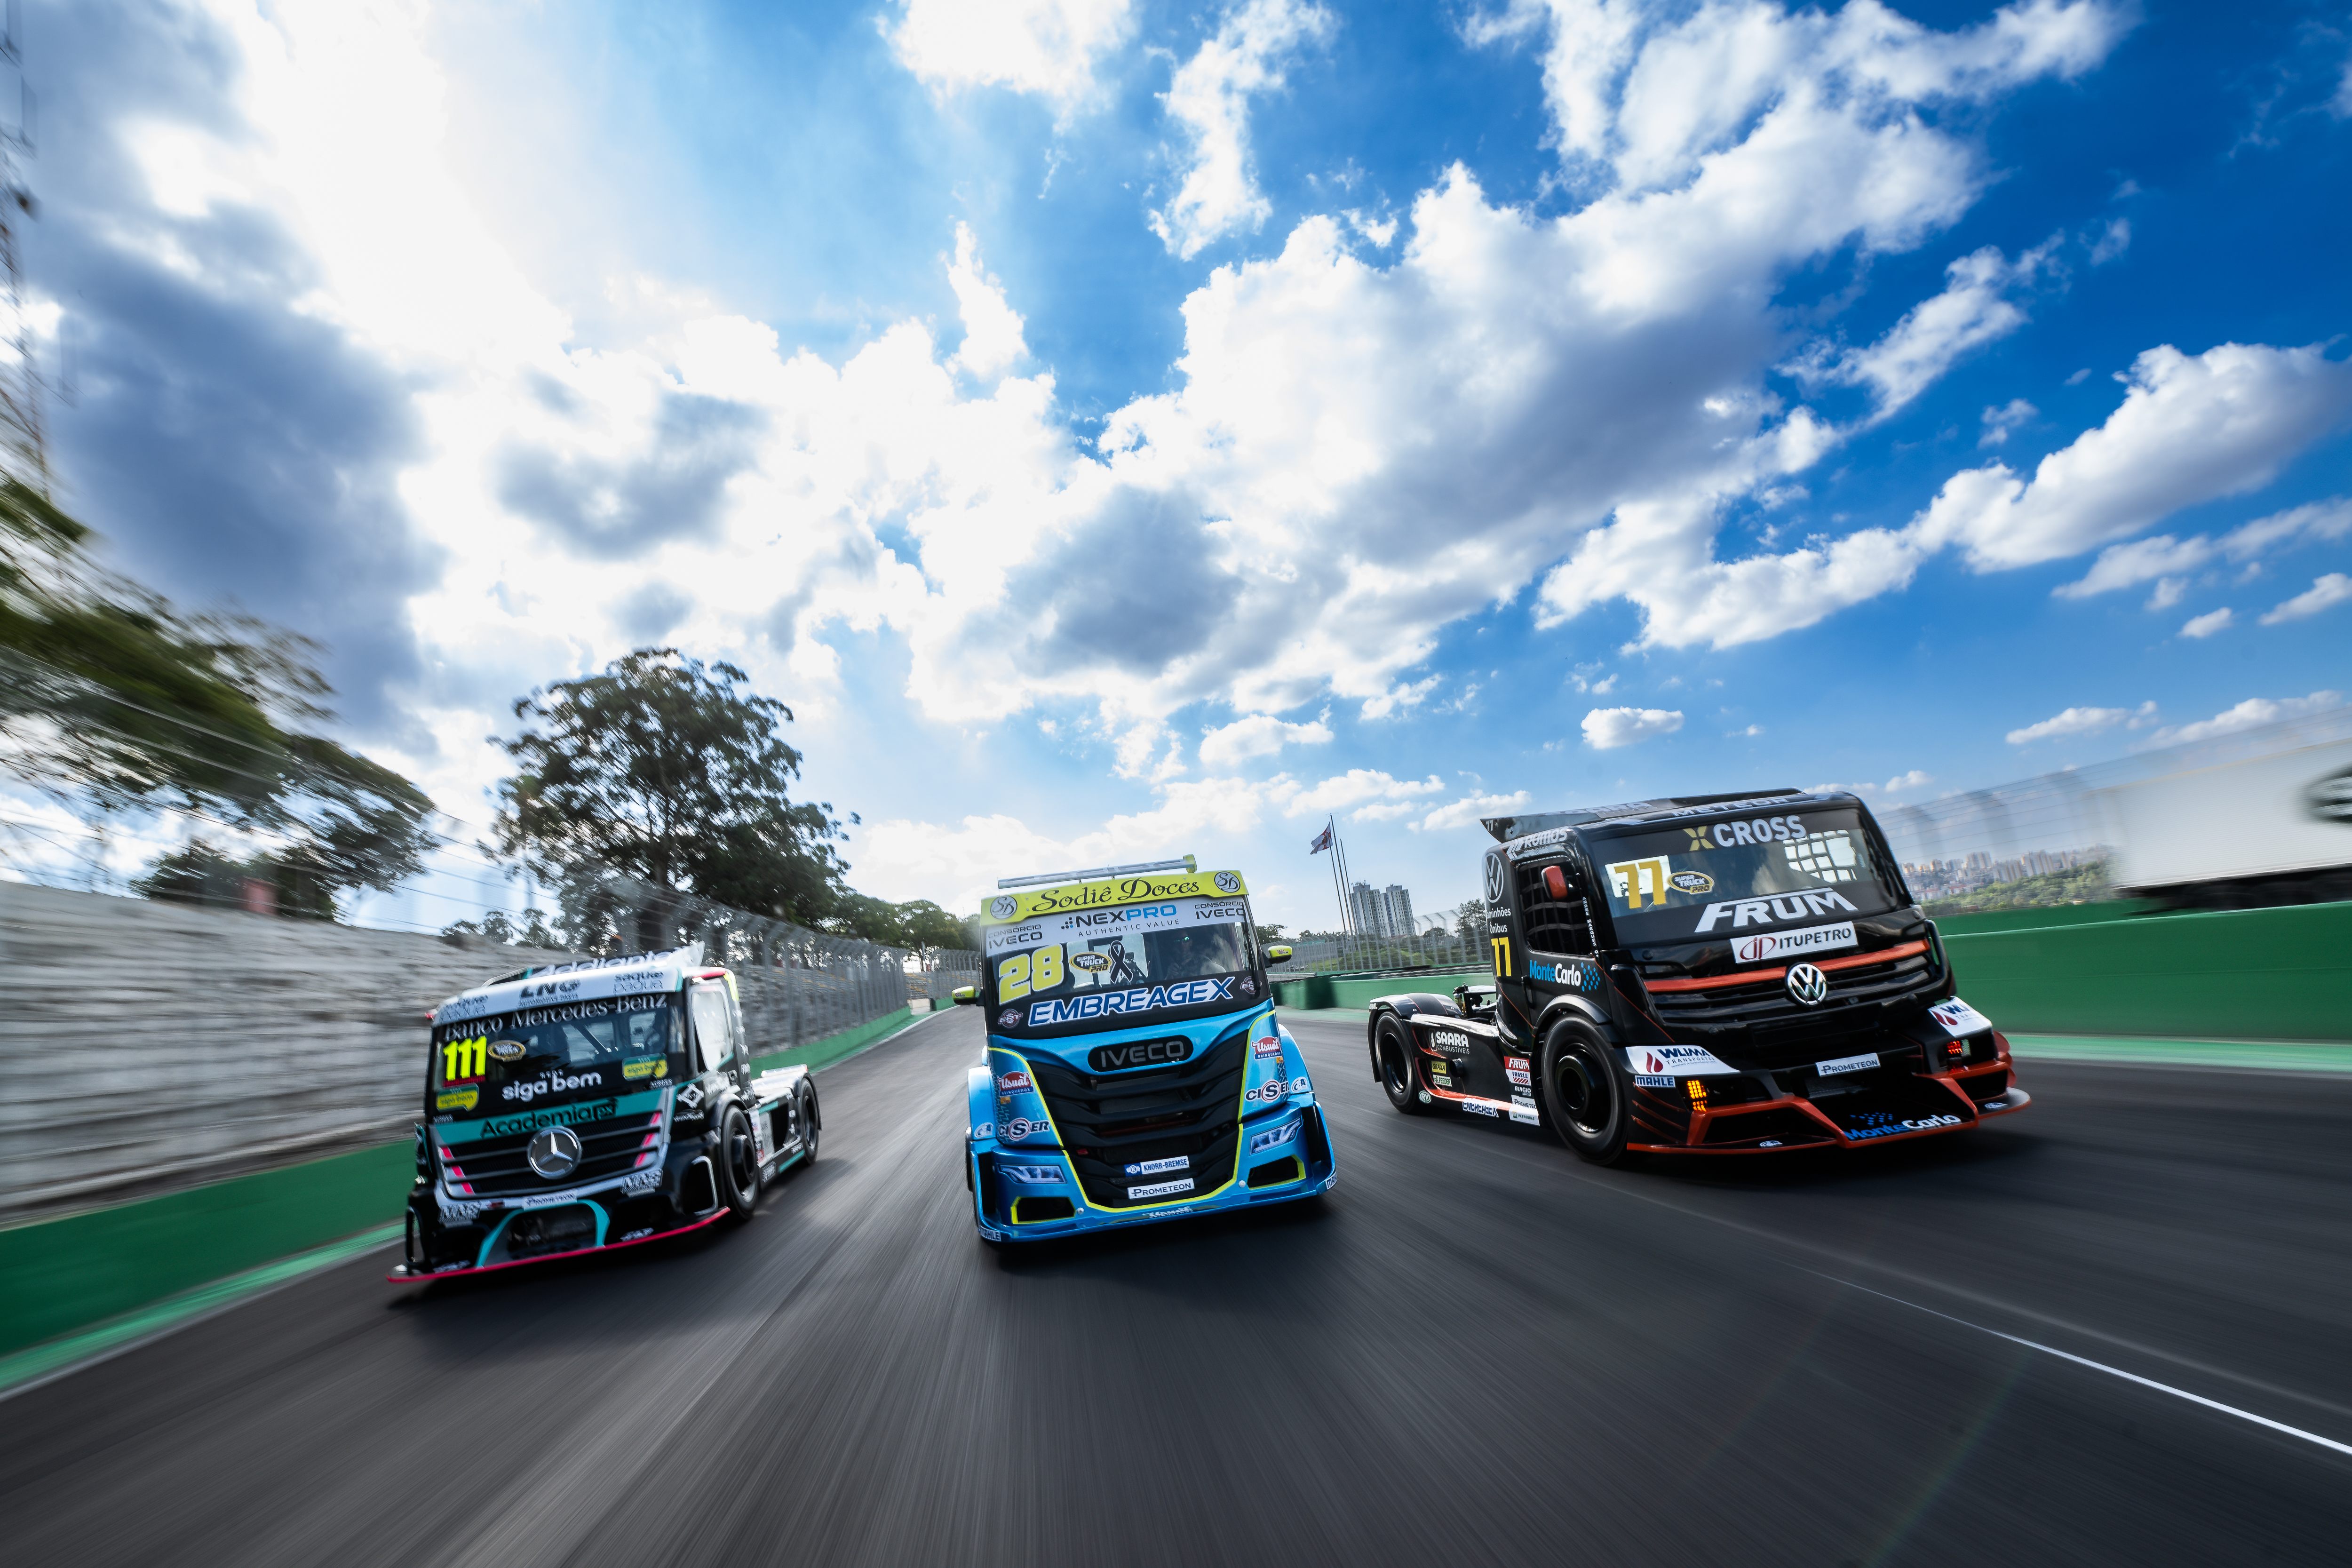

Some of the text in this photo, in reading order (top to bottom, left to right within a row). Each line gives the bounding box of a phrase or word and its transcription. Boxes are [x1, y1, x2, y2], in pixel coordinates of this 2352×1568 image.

[1671, 797, 1789, 817] METEOR
[1613, 860, 1667, 909] 77
[1678, 877, 1705, 887] TRUCK
[1032, 877, 1200, 912] Sodiê Doces
[1194, 900, 1243, 909] CONSÓRCIO
[1693, 887, 1859, 933] FRUM
[1075, 904, 1176, 927] NEXPRO
[1195, 908, 1245, 920] IVECO
[988, 924, 1041, 939] CONSÓRCIO
[1078, 919, 1179, 937] AUTHENTIC VALUE
[1489, 921, 1508, 934] Ônibus
[989, 931, 1043, 949] IVECO
[1780, 927, 1851, 950] ITUPETRO
[1080, 957, 1104, 966] TRUCK
[1491, 937, 1511, 977] 77
[999, 943, 1065, 1006] 28
[1030, 977, 1235, 1026] EMBREAGEX
[444, 1017, 503, 1042] Banco
[509, 994, 667, 1030] Mercedes-Benz
[1252, 1037, 1279, 1052] Usual
[1436, 1031, 1469, 1047] SAARA
[1101, 1041, 1184, 1067] IVECO
[1437, 1045, 1470, 1054] COMBUSTÍVEIS
[1657, 1048, 1710, 1059] WLIMA
[444, 1035, 487, 1081] 111
[1509, 1058, 1530, 1070] FRUM
[1821, 1059, 1878, 1074] PROMETEON
[501, 1080, 548, 1102] siga
[552, 1072, 602, 1092] bem
[998, 1073, 1029, 1089] Usual
[1439, 1077, 1451, 1085] FEEDER
[1637, 1076, 1674, 1086] MAHLE
[480, 1103, 591, 1139] Academia
[999, 1121, 1049, 1136] CISER
[1843, 1115, 1961, 1139] MonteCarlo
[1144, 1159, 1188, 1171] KNORR-BREMSE
[1131, 1182, 1192, 1197] PROMETEON
